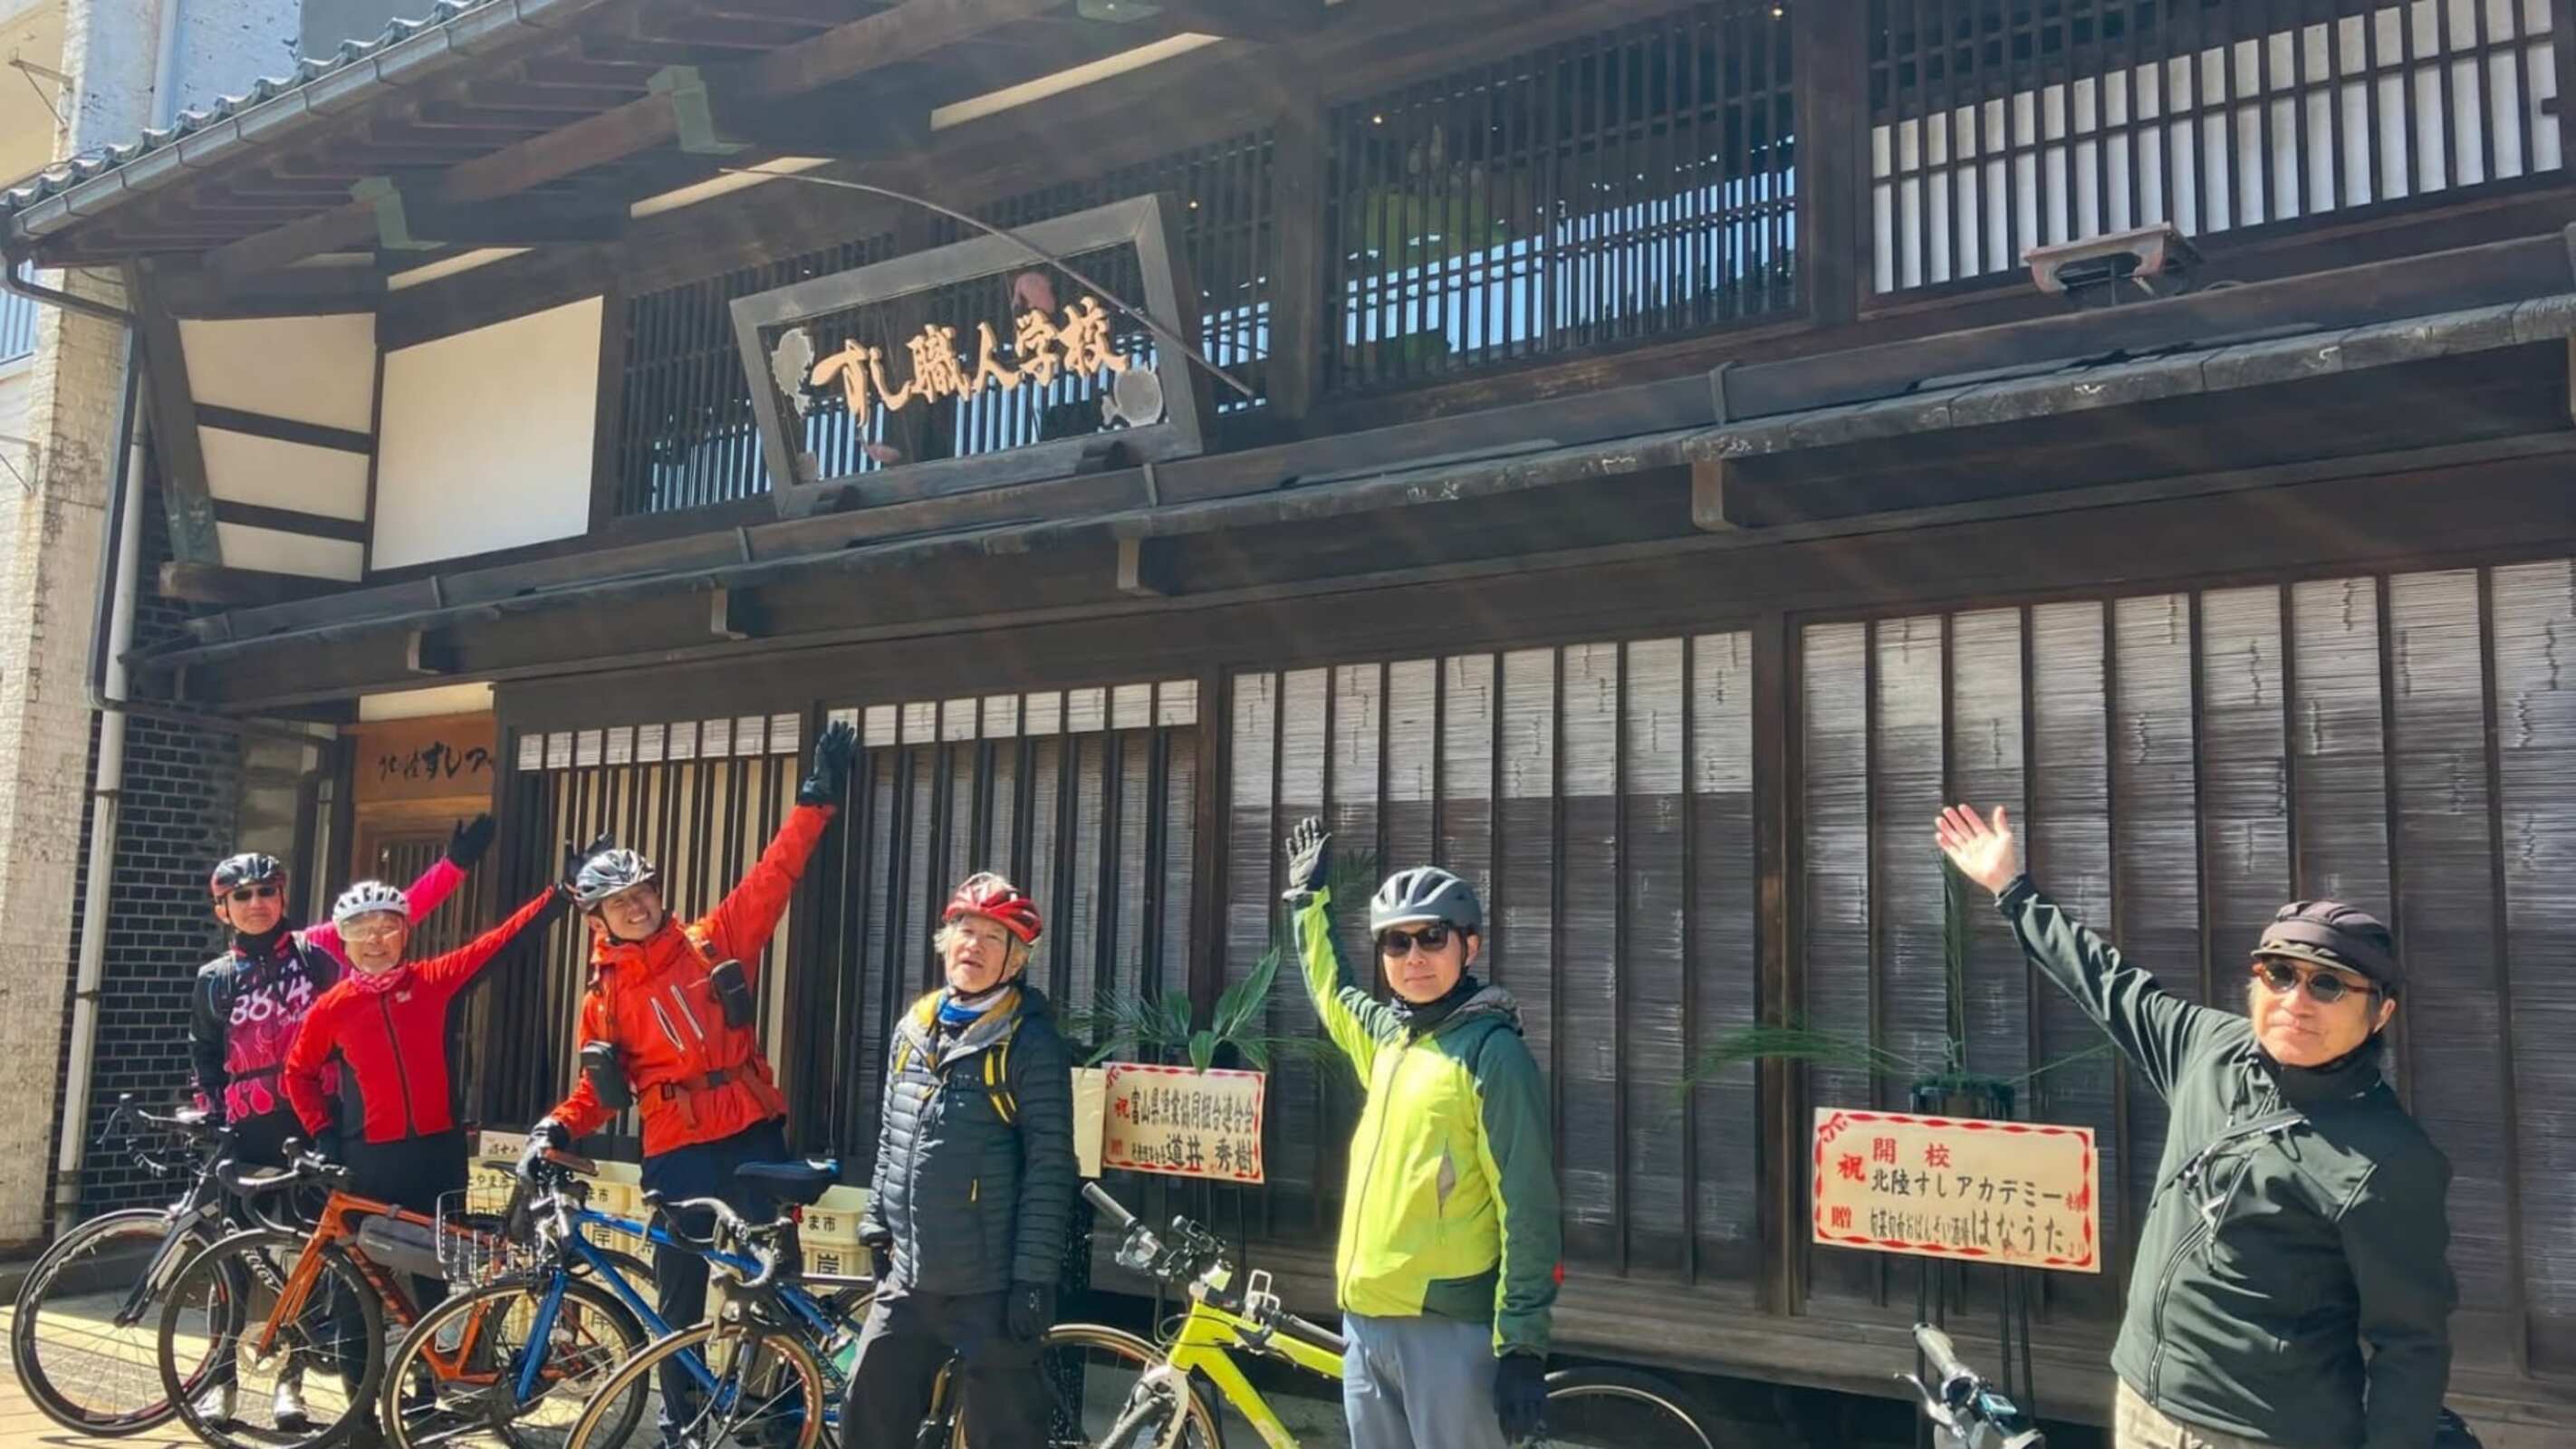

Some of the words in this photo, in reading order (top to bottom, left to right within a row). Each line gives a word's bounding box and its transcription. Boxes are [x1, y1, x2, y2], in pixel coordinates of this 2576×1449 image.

[810, 295, 1130, 427] すし職人学校
[1837, 1153, 1867, 1183] 祝
[1831, 1205, 1853, 1230] 贈
